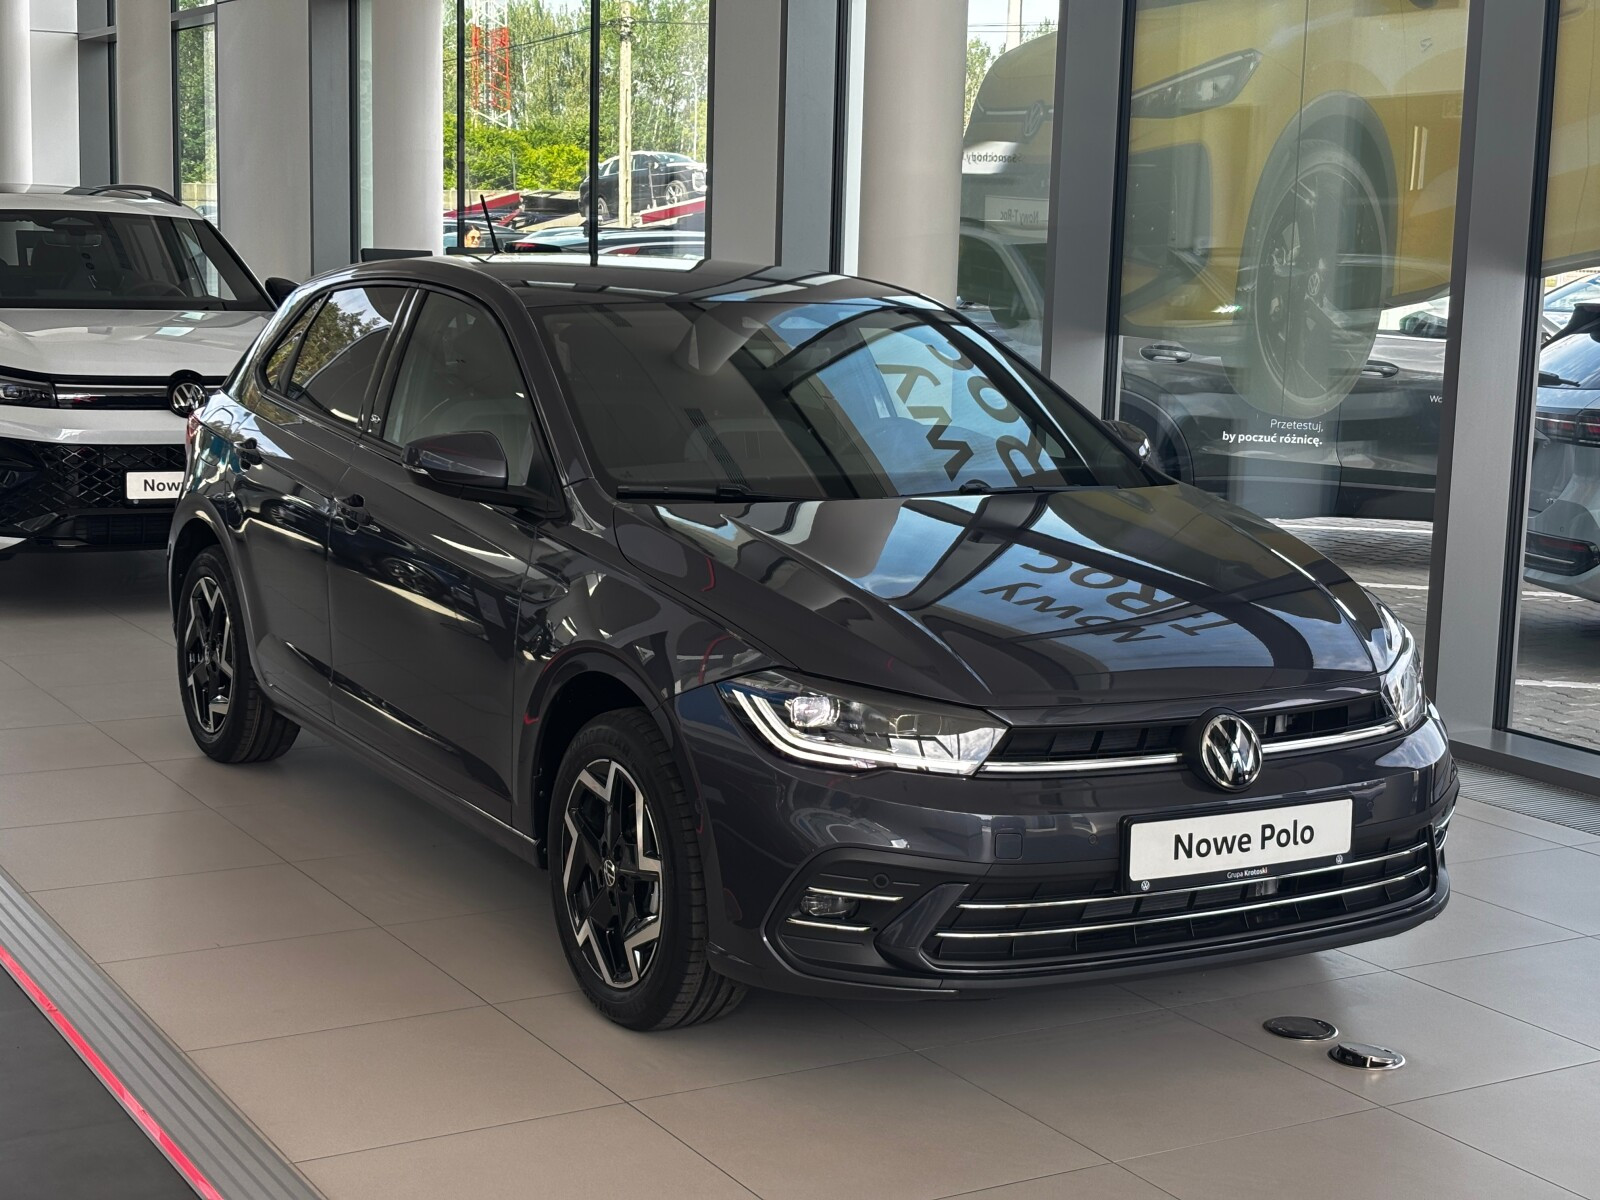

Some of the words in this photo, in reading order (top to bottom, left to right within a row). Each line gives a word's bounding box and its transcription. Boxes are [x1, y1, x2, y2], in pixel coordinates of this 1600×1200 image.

[1270, 419, 1324, 432] Przetestuj,
[1222, 431, 1236, 443] by
[1238, 432, 1277, 444] poczuć
[1279, 434, 1323, 447] różnicę.
[143, 479, 184, 492] Now
[1173, 832, 1252, 860] Nowe
[1260, 819, 1315, 850] Polo
[1226, 871, 1244, 879] Grupa
[1244, 867, 1268, 876] Krotoski
